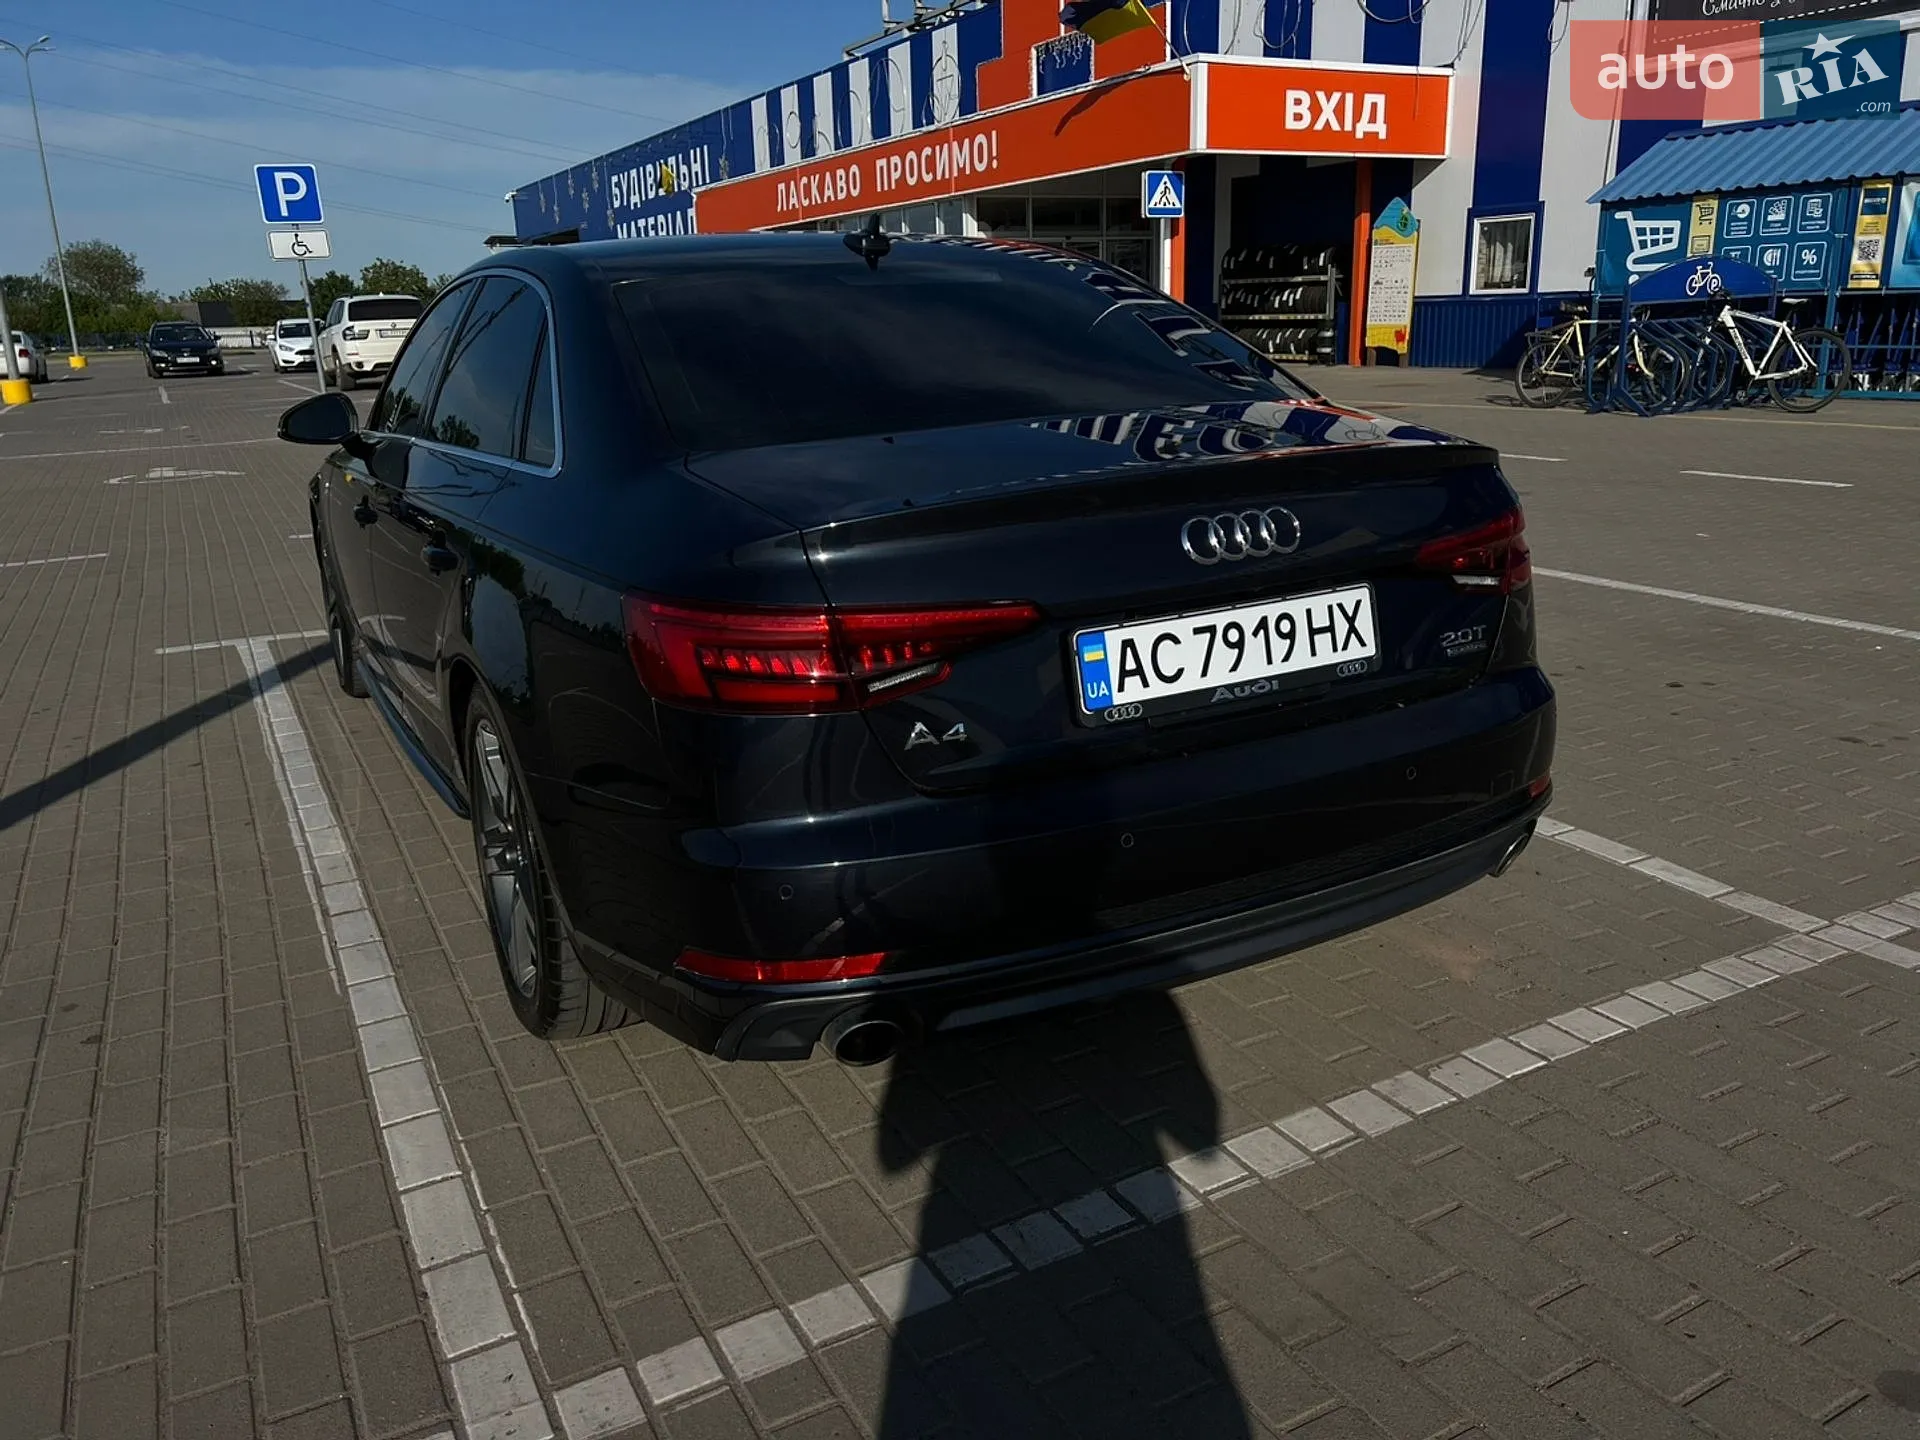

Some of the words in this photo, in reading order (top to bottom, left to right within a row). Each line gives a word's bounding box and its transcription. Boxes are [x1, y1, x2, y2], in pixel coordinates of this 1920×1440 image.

[1284, 89, 1388, 140] ВХІД
[273, 171, 307, 217] P
[777, 164, 861, 212] ЛАСКАВО
[875, 130, 999, 193] ПРОСИМО!
[1087, 680, 1110, 699] UA
[904, 721, 968, 751] A4
